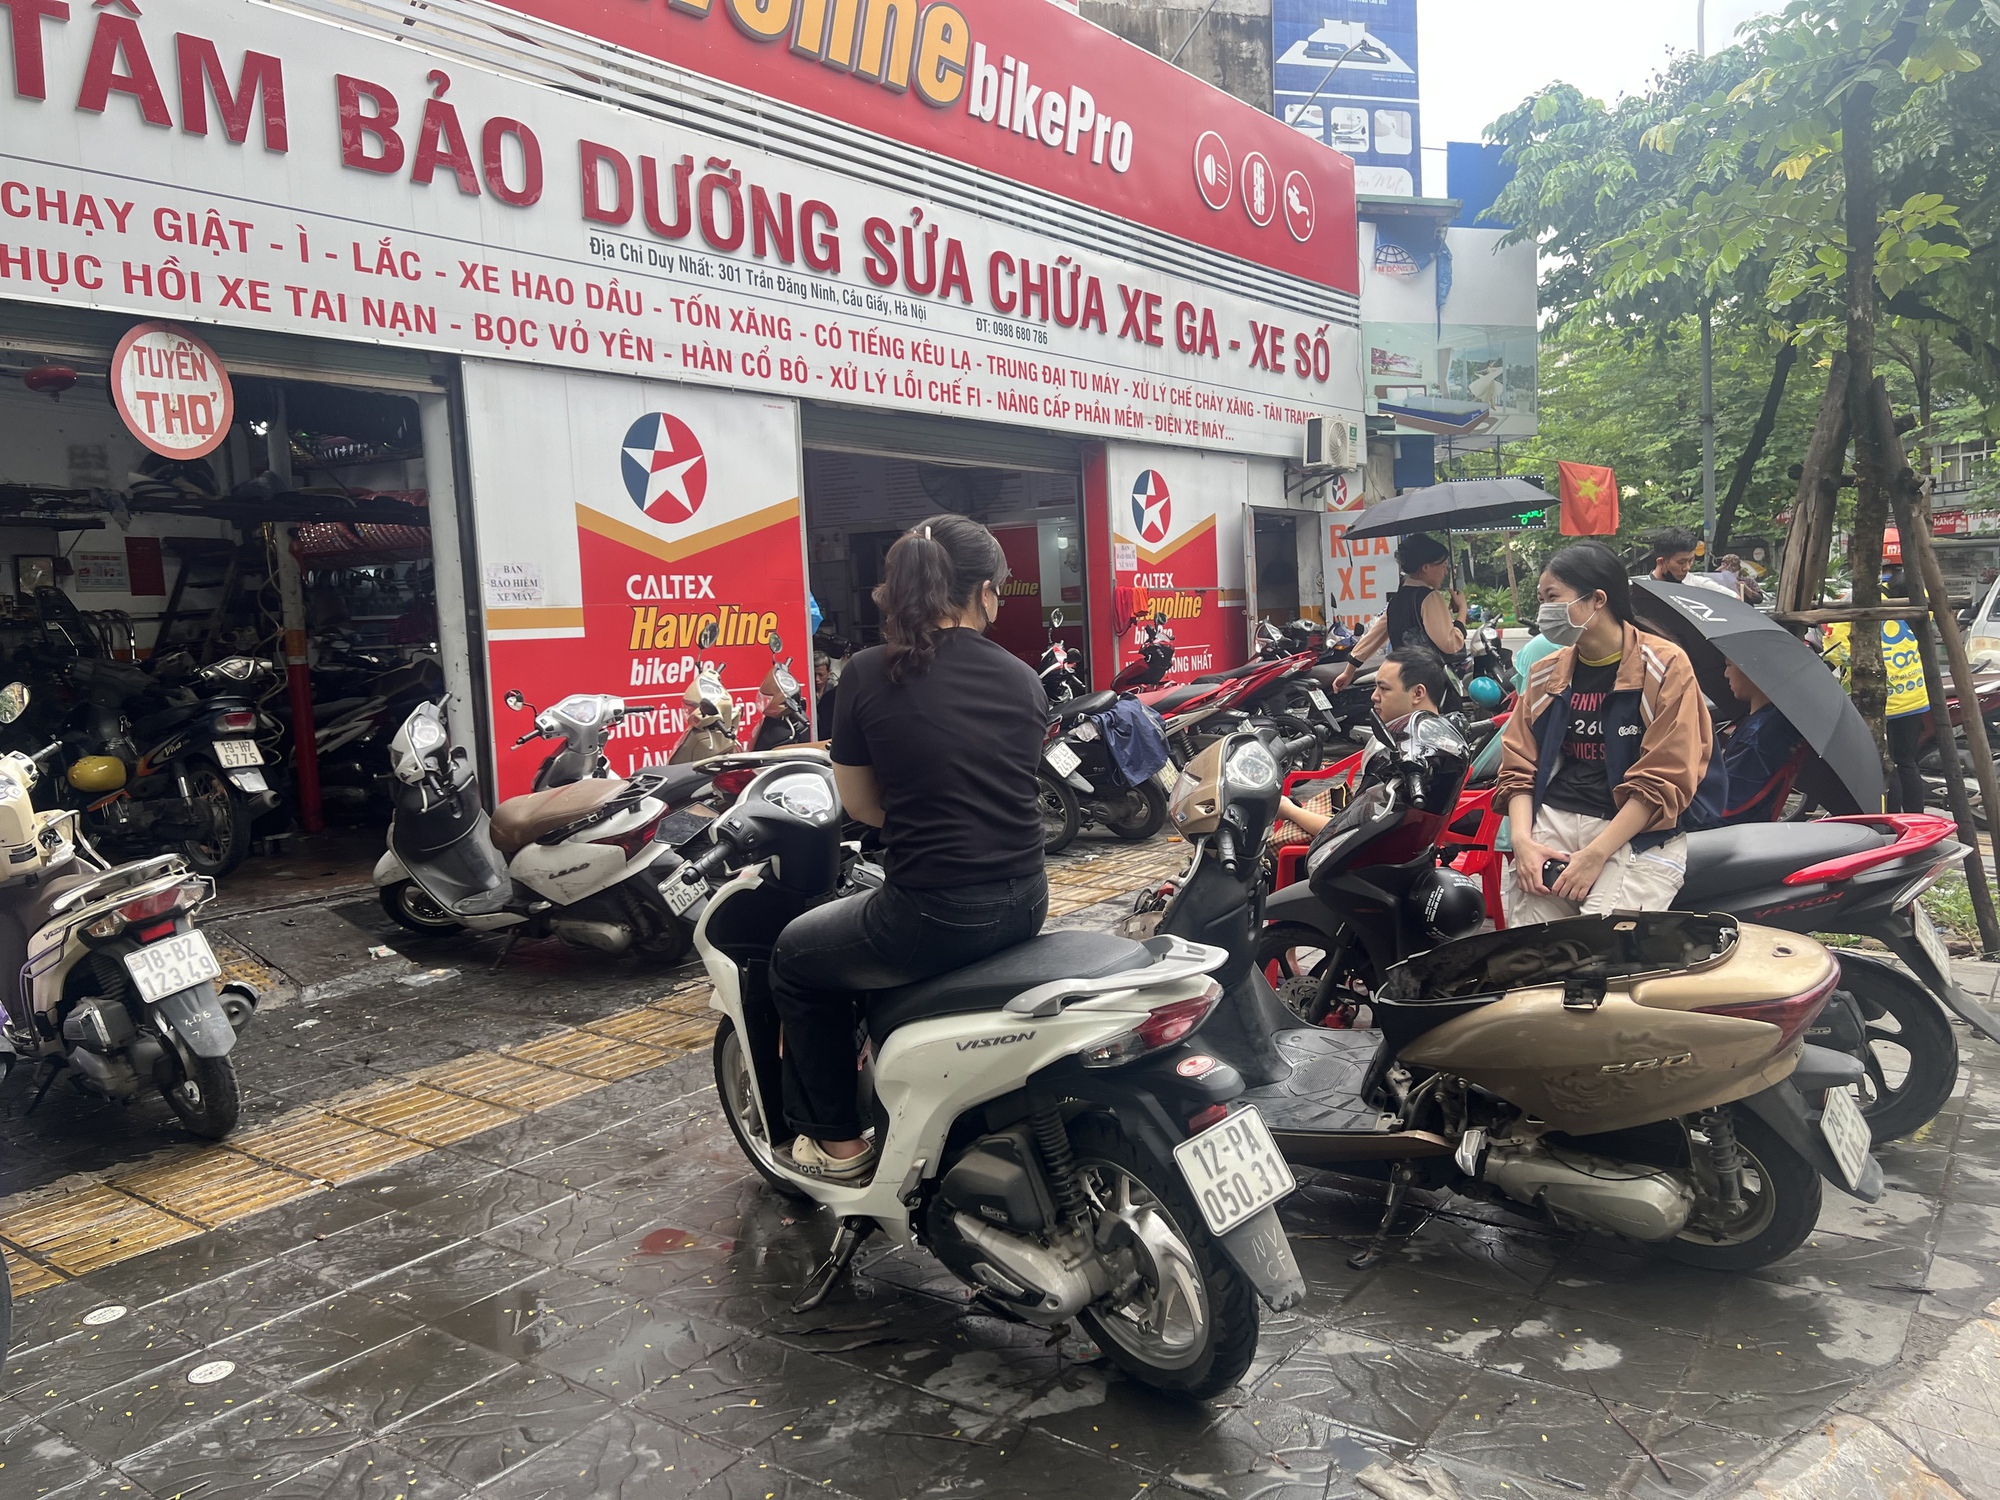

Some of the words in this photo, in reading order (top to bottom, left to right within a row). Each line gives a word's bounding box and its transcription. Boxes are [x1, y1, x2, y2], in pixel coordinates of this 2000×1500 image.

[967, 41, 1133, 174] bikePro
[0, 0, 288, 153] TÂM
[334, 69, 544, 207] BẢO
[577, 138, 841, 274] DƯỠNG
[863, 206, 974, 305] SỬA
[988, 250, 1108, 334] CHỮA
[1117, 283, 1164, 347] XE
[1175, 300, 1220, 359] GA
[1249, 320, 1285, 373] XE
[1295, 324, 1330, 383] SỐ
[589, 237, 615, 261] Địa
[620, 242, 643, 264] Chỉ
[648, 249, 674, 273] Duy
[679, 255, 714, 278] Nhất:
[718, 263, 741, 283] 301
[746, 269, 773, 290] Trần
[777, 275, 807, 300] Đăng
[811, 282, 839, 305] Ninh,
[842, 288, 863, 308] Cầu
[866, 291, 892, 316] Giấy,
[894, 300, 908, 317] Hà
[911, 304, 927, 323] Nội
[1, 181, 135, 236] CHẠY
[153, 207, 254, 256] GIẬT
[296, 223, 309, 263] Ì
[352, 236, 421, 281] LẮC
[458, 260, 500, 294] XE
[511, 270, 574, 305] HAO
[585, 277, 642, 316] DẦU
[670, 294, 721, 329] TỐN
[729, 306, 792, 341] XĂNG
[814, 321, 842, 349] CÓ
[848, 325, 904, 360] TIẾNG
[911, 338, 944, 367] KÊU
[951, 348, 972, 375] LẠ
[986, 354, 1038, 382] TRUNG
[1041, 365, 1066, 392] ĐẠI
[1070, 369, 1087, 390] TU
[1092, 372, 1119, 395] MÁY
[1132, 377, 1150, 400] XỬ
[1153, 380, 1168, 402] LÝ
[1170, 385, 1192, 407] CHẾ
[1195, 390, 1224, 412] CHẢY
[1226, 395, 1254, 417] XĂNG
[1263, 402, 1282, 421] TÂN
[122, 255, 201, 303] HỒI
[217, 274, 272, 313] XE
[284, 284, 347, 323] TAI
[361, 296, 437, 337] NẠN
[474, 312, 538, 350] BỌC
[549, 318, 589, 354] VỎ
[598, 328, 654, 363] YÊN
[682, 340, 733, 374] HÀN
[741, 345, 771, 379] CỔ
[780, 355, 808, 384] BÔ
[830, 361, 857, 390] XỬ
[864, 367, 887, 394] LÝ
[894, 369, 922, 399] LỖI
[928, 377, 962, 405] CHẾ
[967, 386, 981, 408] FI
[997, 388, 1038, 415] NÂNG
[1043, 393, 1070, 419] CẤP
[1074, 399, 1111, 424] PHẦN
[1114, 403, 1143, 429] MỀM
[1155, 412, 1181, 436] ĐIỆN
[1185, 418, 1199, 437] XE
[976, 317, 991, 334] ĐT:
[993, 320, 1014, 338] 0988
[1015, 325, 1031, 342] 680
[1033, 329, 1048, 345] 786
[133, 341, 208, 381] TUYỂN
[136, 391, 217, 440] THỢ
[626, 574, 715, 600] CALTEX
[1000, 579, 1039, 596] oline
[1134, 573, 1174, 589] CALTEX
[1337, 565, 1376, 601] XE
[1136, 591, 1203, 621] avoline
[1191, 648, 1212, 671] NHẤT
[221, 741, 250, 753] 19-H7
[225, 753, 258, 766] 6775
[143, 955, 214, 996] 123.49
[956, 1030, 1036, 1051] VISION
[1197, 1065, 1227, 1080] HONDA
[1192, 1118, 1262, 1180] 12-PA
[1203, 1152, 1287, 1225] 050.31
